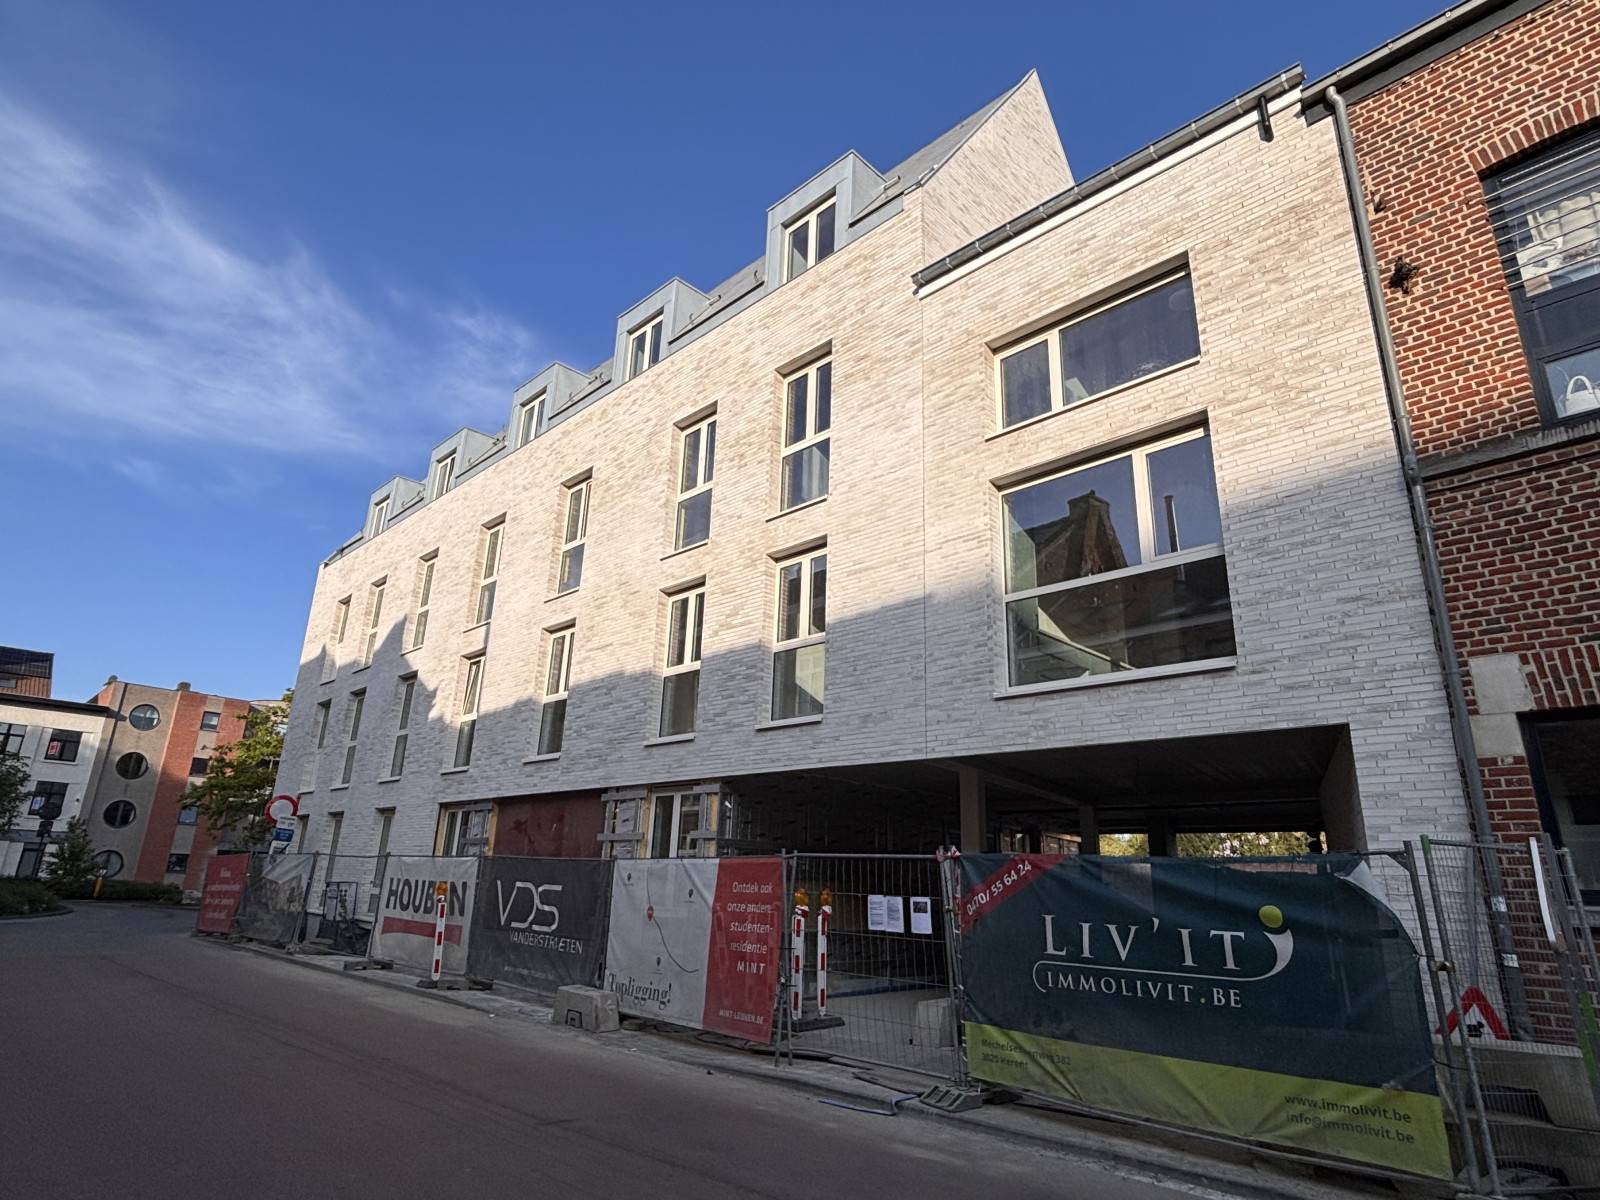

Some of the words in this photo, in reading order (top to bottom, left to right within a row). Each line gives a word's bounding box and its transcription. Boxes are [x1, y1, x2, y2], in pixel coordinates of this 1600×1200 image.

[732, 881, 759, 893] Ontdek
[760, 881, 774, 893] ook
[991, 880, 1004, 897] 55
[1003, 869, 1018, 886] 64
[1017, 859, 1032, 877] 24
[385, 877, 467, 917] HOUBN
[496, 879, 563, 933] VDS
[727, 902, 746, 912] onze
[746, 902, 772, 913] andere
[729, 920, 773, 934] studenten-
[730, 940, 768, 954] residentie
[736, 960, 766, 975] MINT
[609, 973, 672, 1011] Topligging!
[1047, 971, 1242, 1009] IMMOLIVIT.BE
[1056, 1054, 1071, 1066] 382
[1284, 1094, 1412, 1123] www.immolivit.be
[1286, 1111, 1415, 1144] info@immolivit.be
